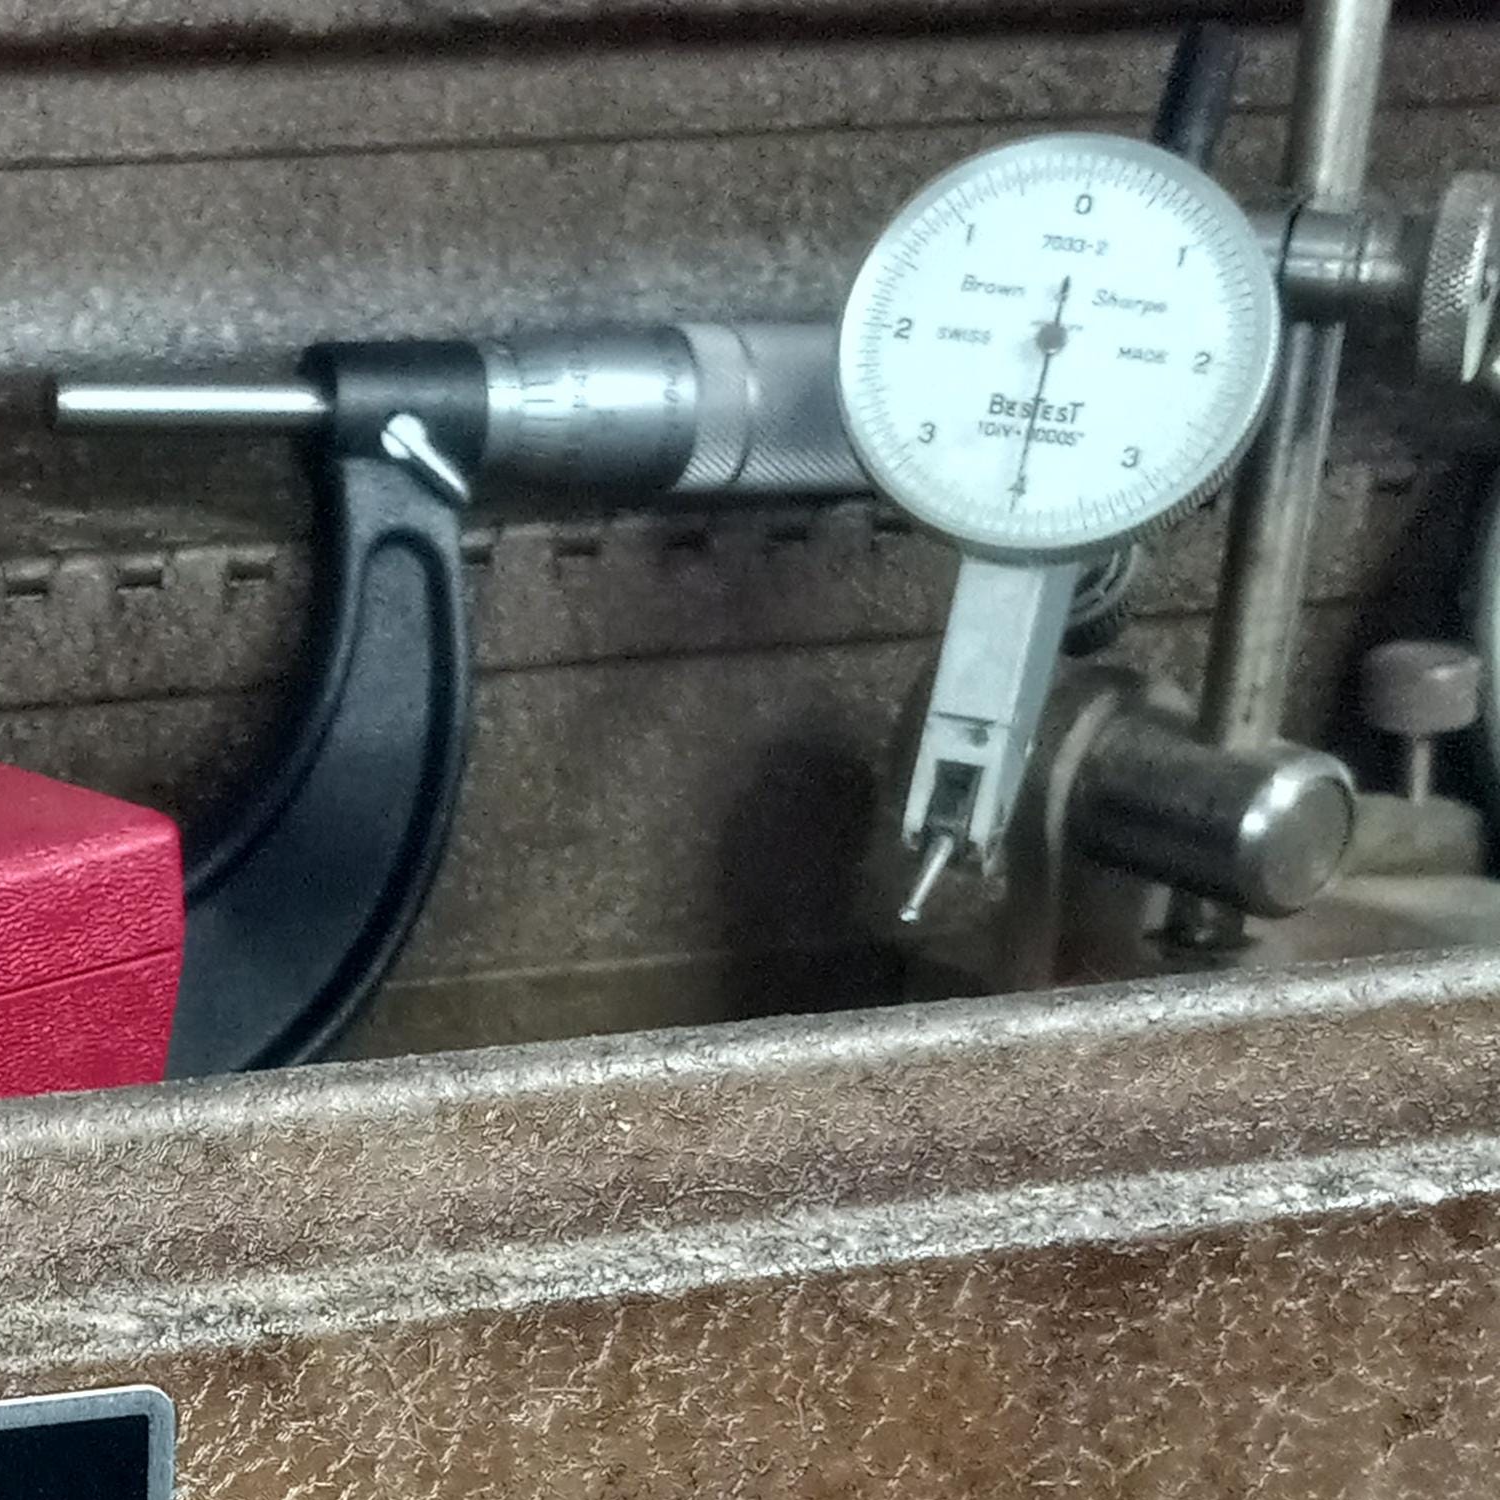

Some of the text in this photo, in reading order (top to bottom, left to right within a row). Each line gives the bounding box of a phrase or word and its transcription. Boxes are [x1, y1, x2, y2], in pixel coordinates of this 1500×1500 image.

[1074, 193, 1093, 216] 0
[965, 222, 976, 246] 1
[1176, 245, 1189, 268] 1
[960, 272, 1027, 297] Brown
[1091, 288, 1169, 316] Sharpe
[893, 316, 913, 341] 2
[936, 326, 1170, 365] SWISS MADE
[1192, 350, 1212, 375] 2
[917, 422, 938, 445] 3
[1121, 446, 1142, 469] 3
